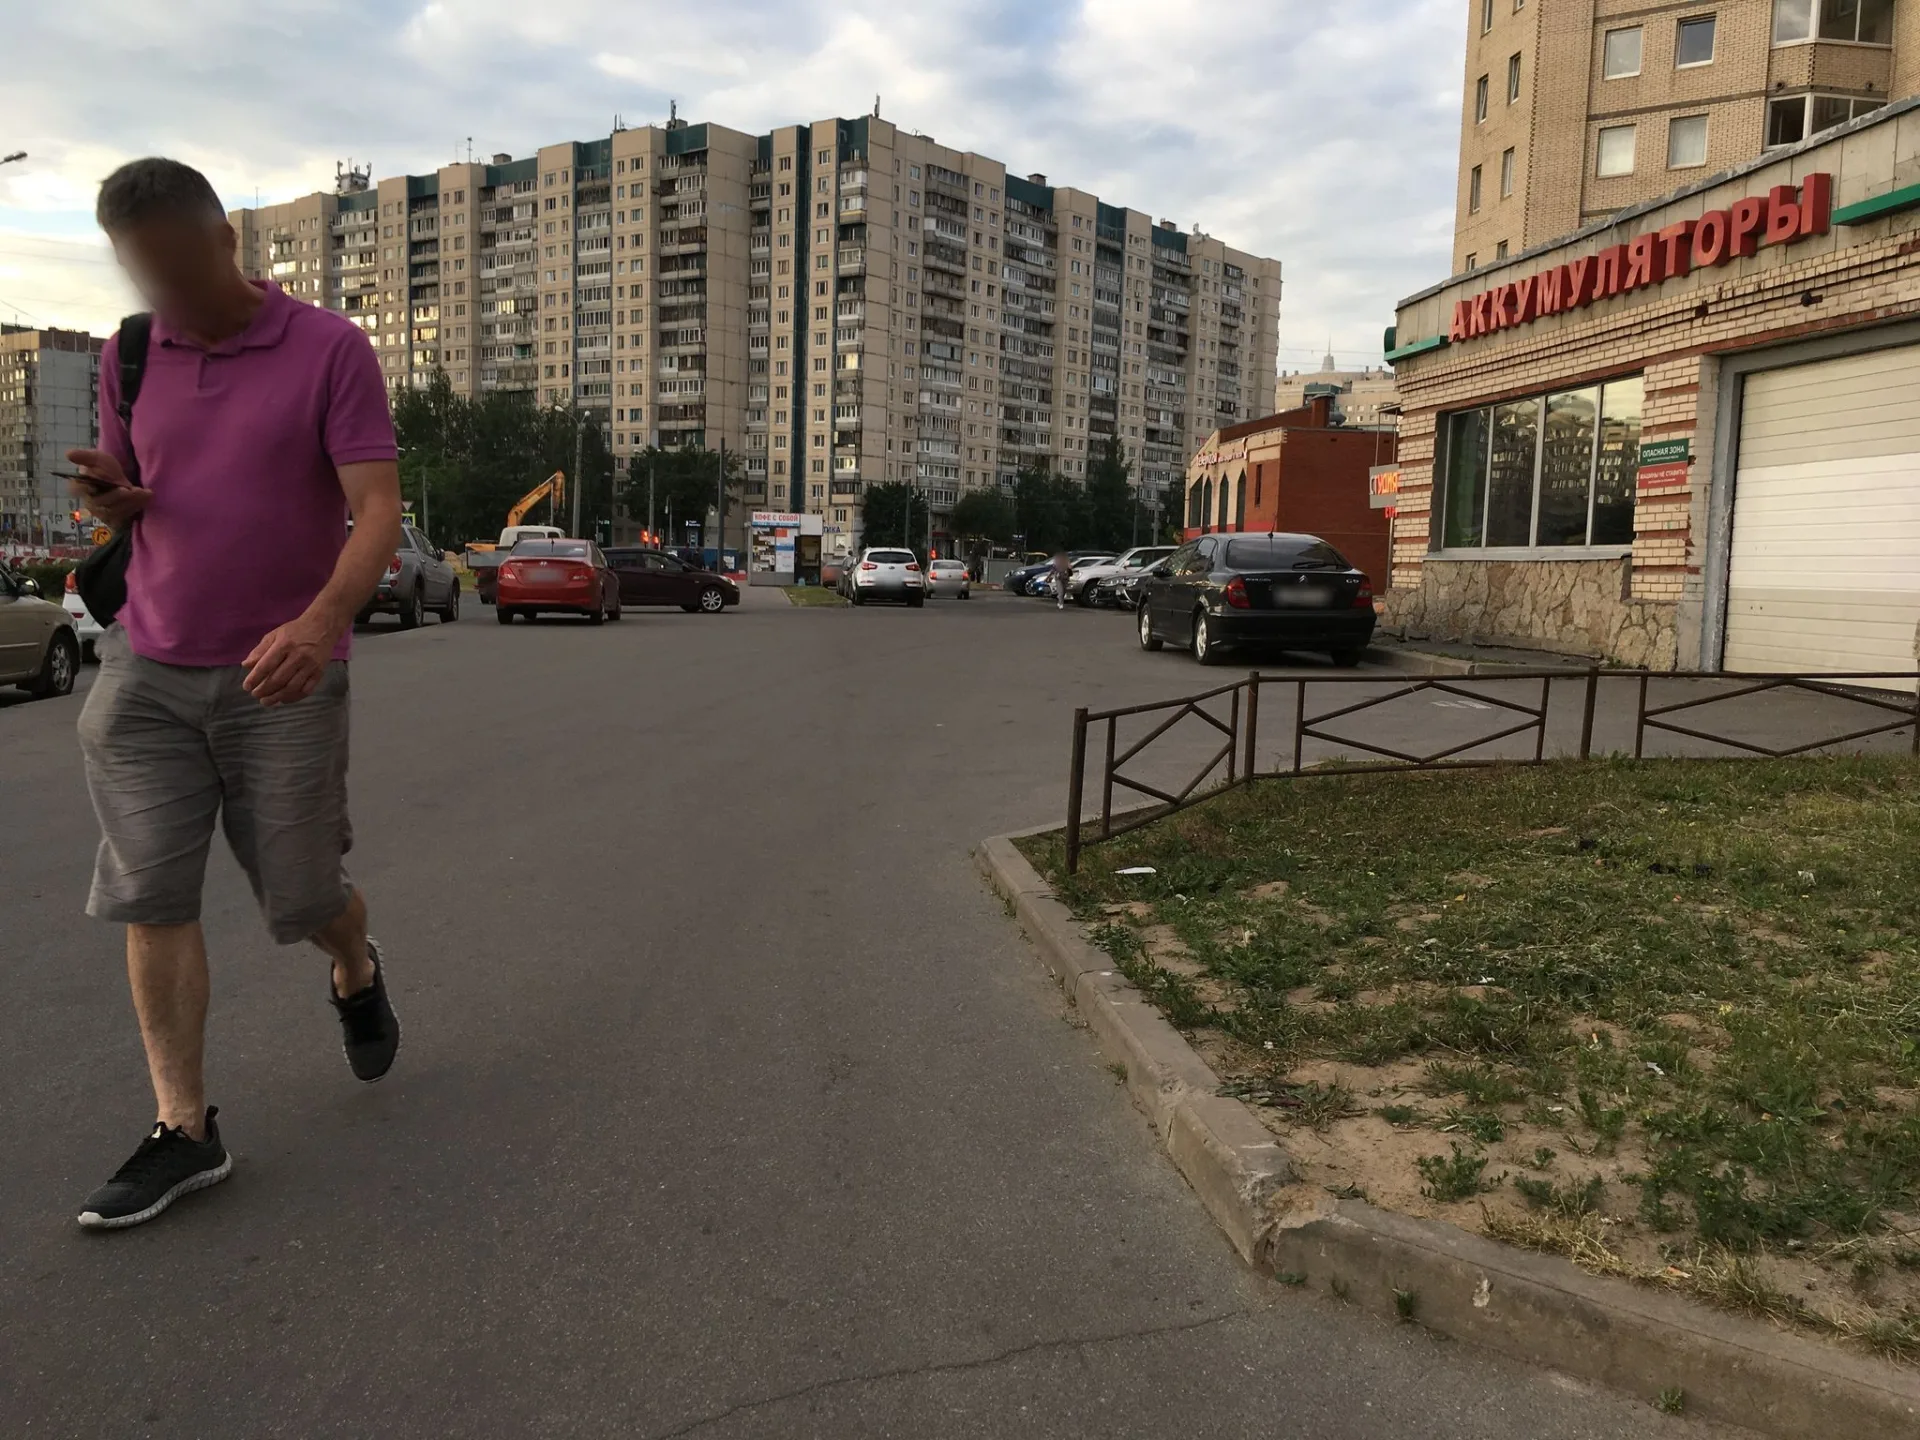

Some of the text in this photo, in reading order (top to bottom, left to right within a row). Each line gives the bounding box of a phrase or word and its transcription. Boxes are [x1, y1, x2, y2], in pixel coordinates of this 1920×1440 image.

[1448, 173, 1830, 342] АККУМУЛЯТОРЫ
[1642, 445, 1685, 457] ОПАСНАЯ ЗОНА
[778, 513, 798, 521] СОБОЙ
